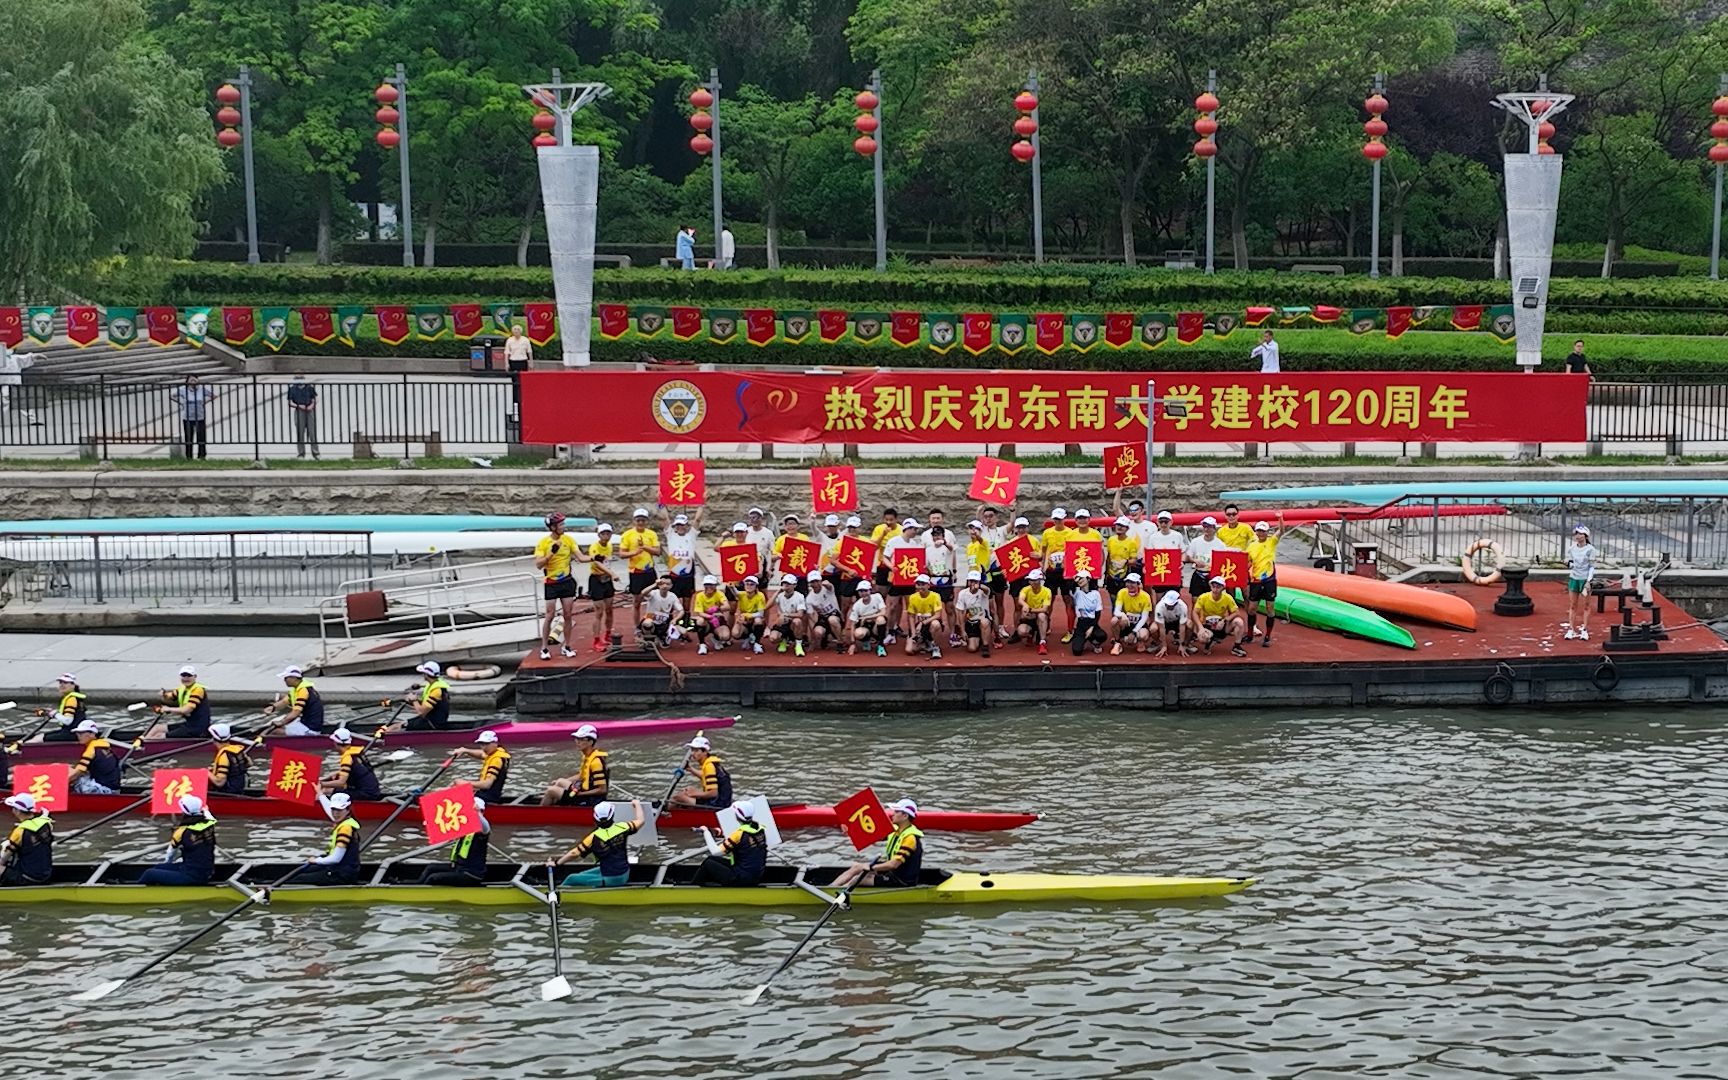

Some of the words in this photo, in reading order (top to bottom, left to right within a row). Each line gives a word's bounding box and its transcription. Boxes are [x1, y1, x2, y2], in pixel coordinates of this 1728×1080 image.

[823, 383, 1470, 431] 热烈庆祝东南大学建校120周年
[669, 463, 695, 501] 東
[819, 472, 850, 506] 南
[982, 465, 1010, 499] 大
[726, 553, 747, 575] 百
[844, 546, 866, 571] 文
[1008, 546, 1031, 574] 英
[1073, 546, 1096, 572] 豪
[1219, 558, 1238, 582] 出
[28, 774, 56, 803] 至
[275, 760, 308, 799] 薪
[848, 804, 877, 834] 百
